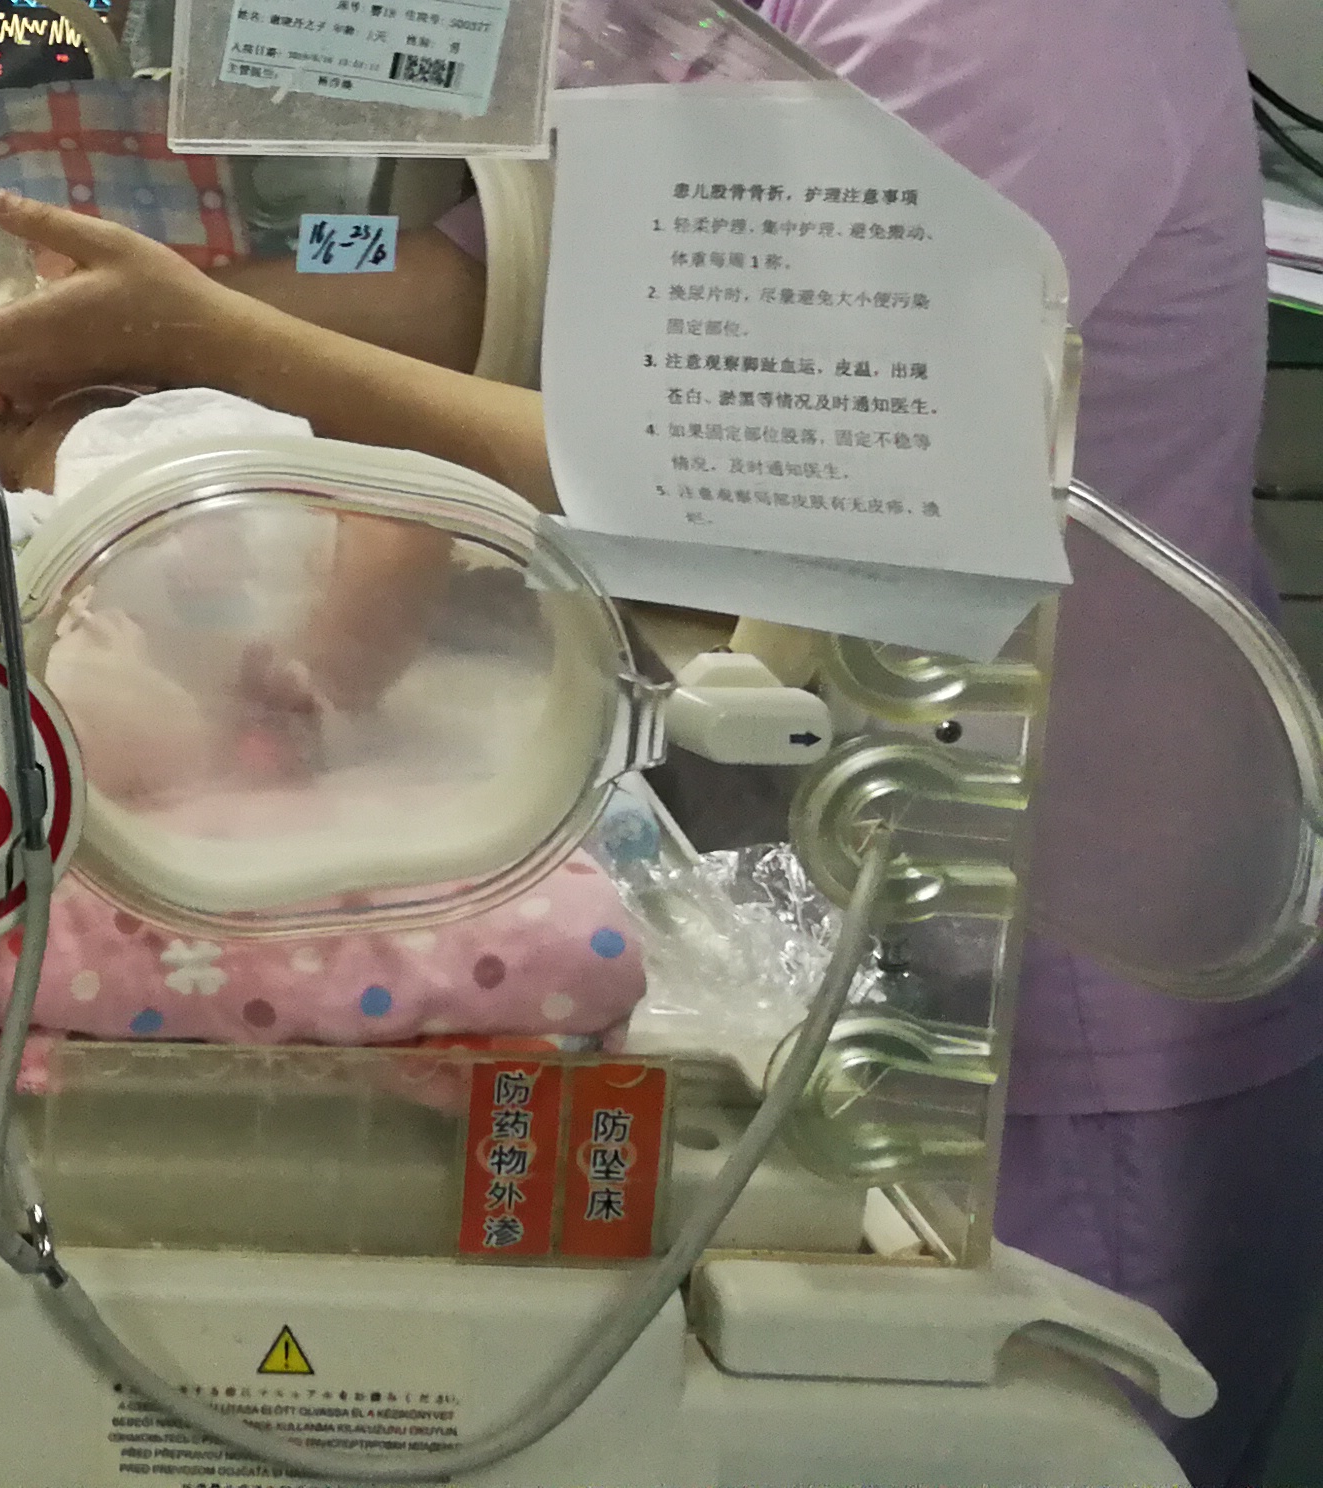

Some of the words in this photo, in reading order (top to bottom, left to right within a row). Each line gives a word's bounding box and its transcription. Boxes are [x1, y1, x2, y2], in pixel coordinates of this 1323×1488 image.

[484, 1070, 533, 1247] 防药物外渗
[585, 1109, 633, 1222] 防坠床
